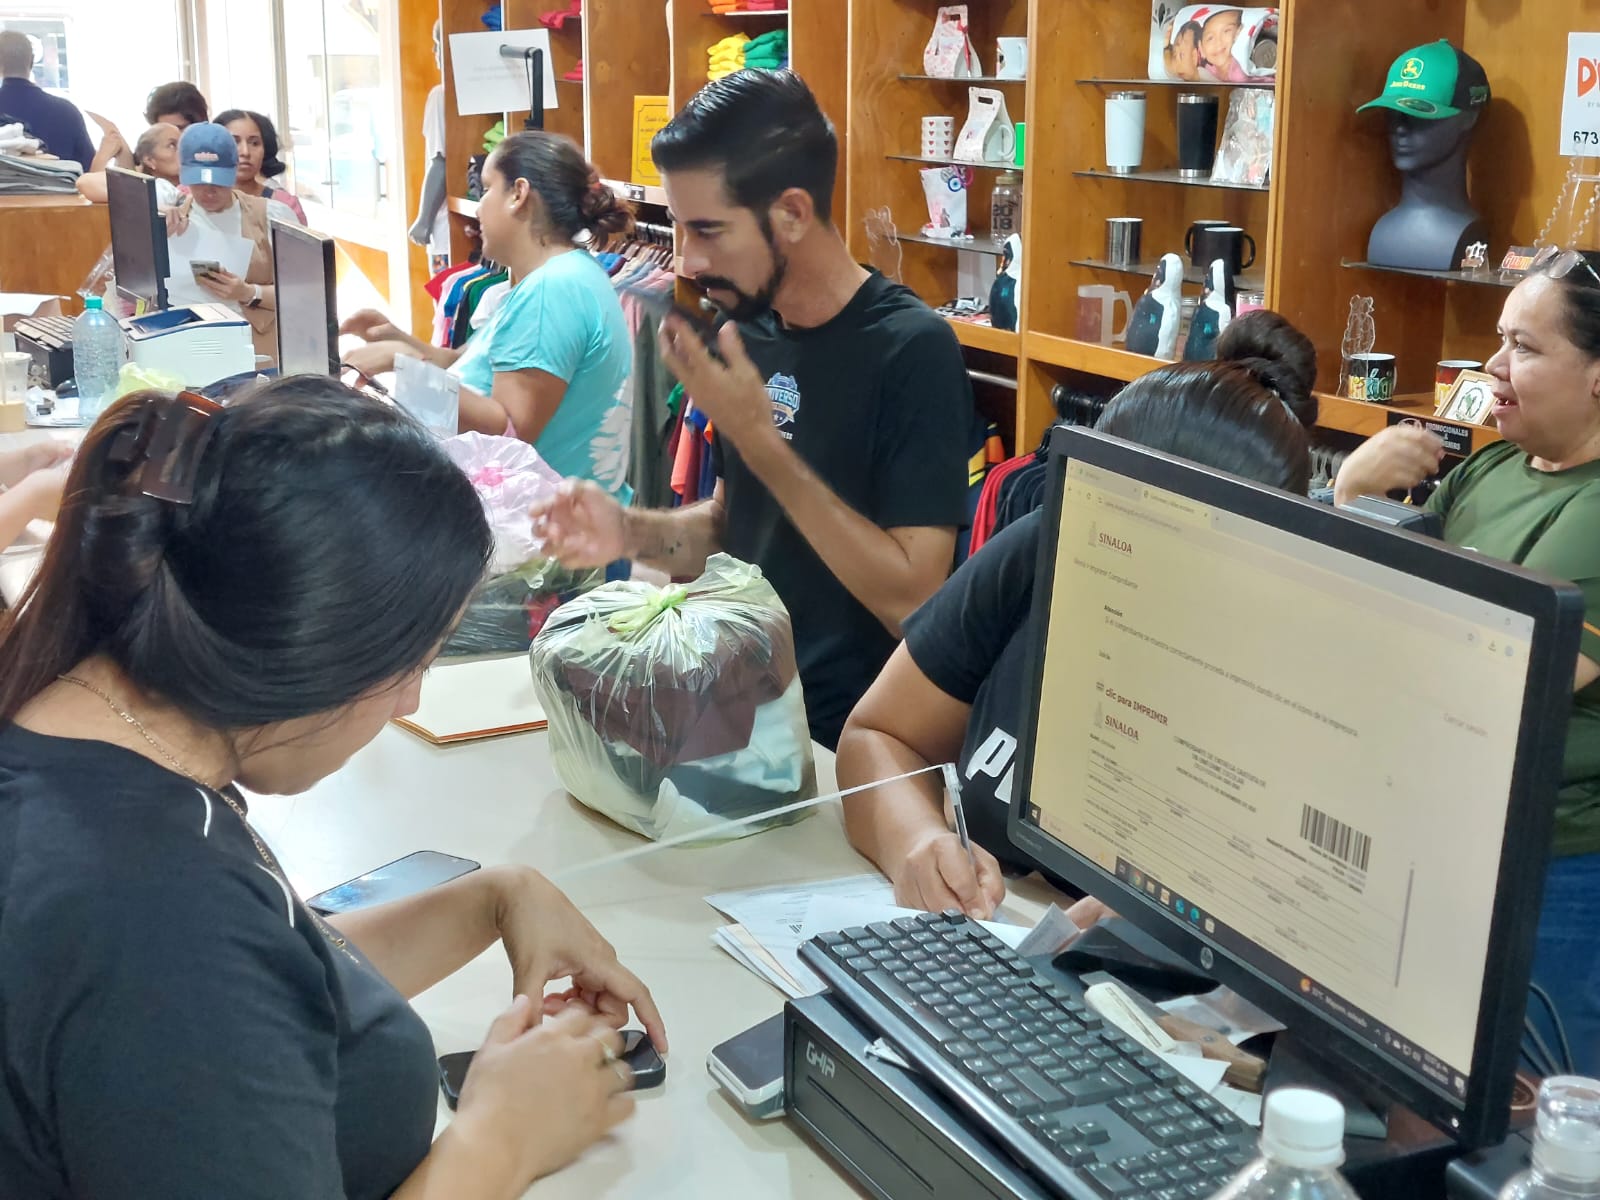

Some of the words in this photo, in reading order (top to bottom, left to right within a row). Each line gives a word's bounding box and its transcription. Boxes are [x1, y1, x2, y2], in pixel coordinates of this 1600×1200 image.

[1573, 131, 1599, 145] 673
[1098, 532, 1133, 554] SINALOA
[1105, 687, 1117, 700] clic
[1117, 695, 1133, 708] para
[1132, 701, 1169, 726] IMPRIMIR
[1104, 715, 1140, 741] SINALOA
[805, 1040, 836, 1079] GHIA
